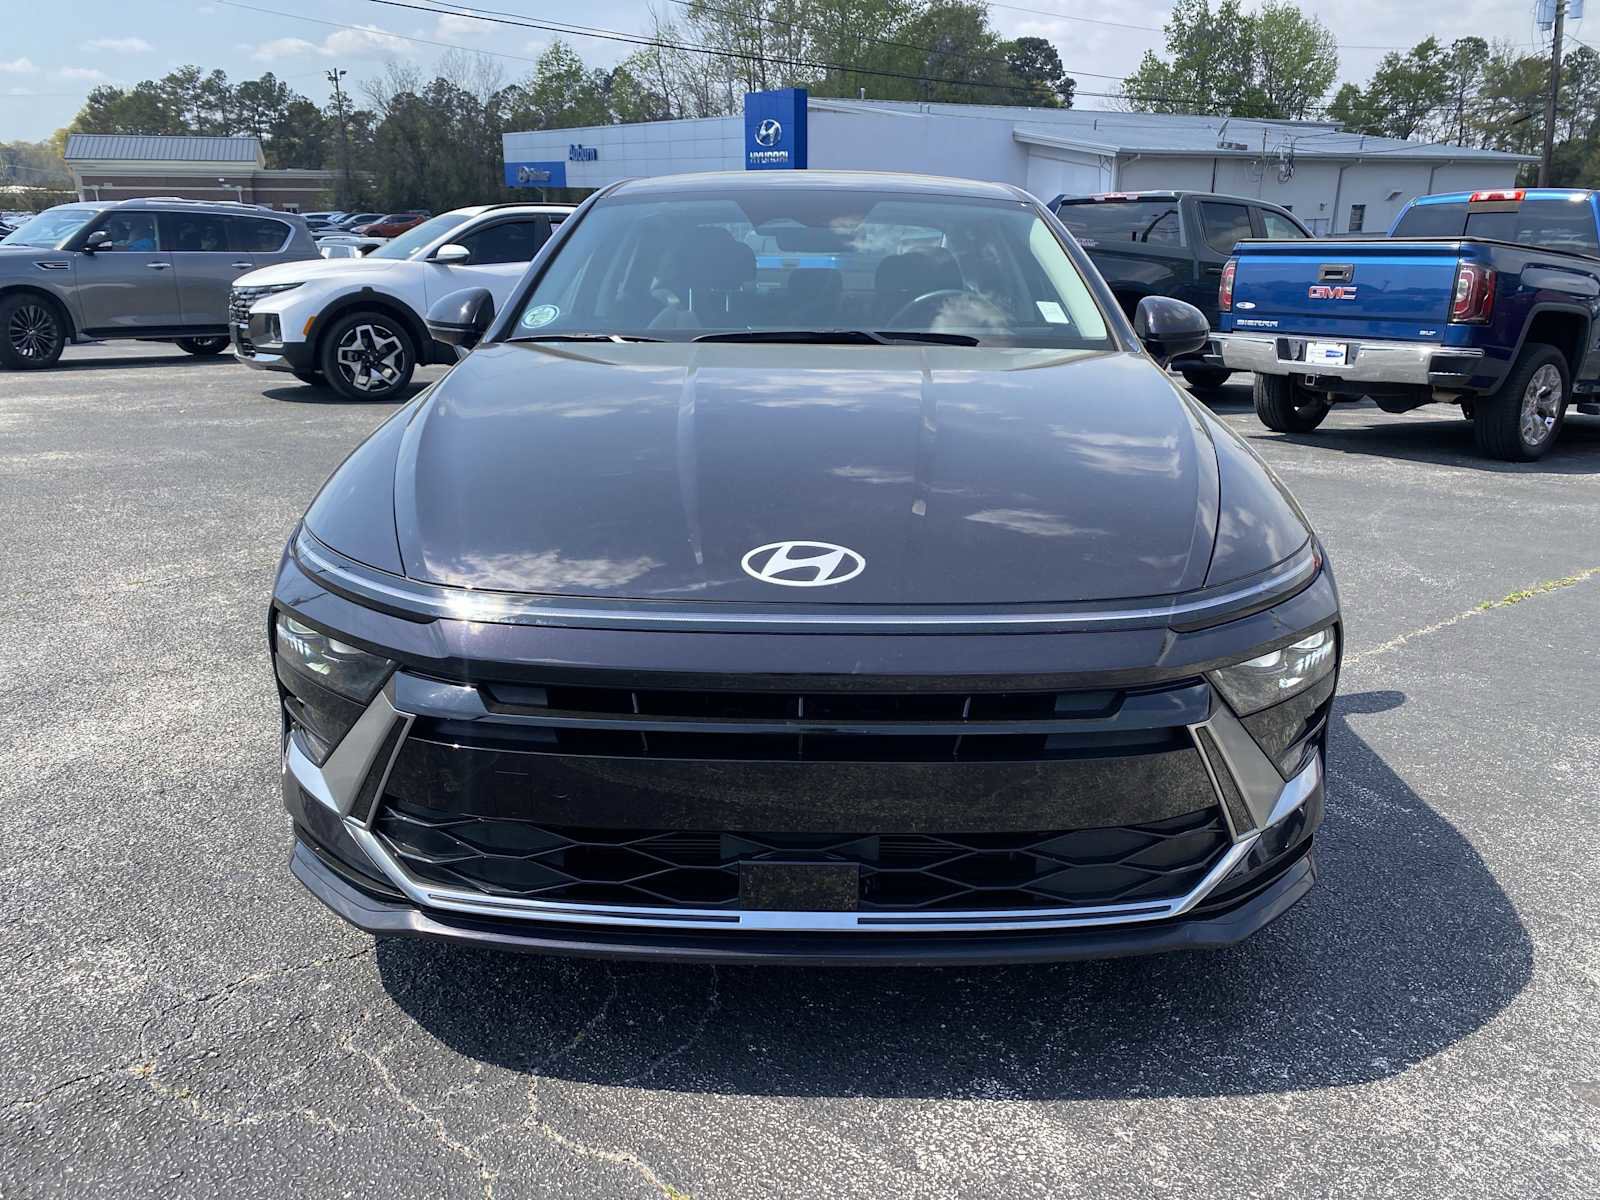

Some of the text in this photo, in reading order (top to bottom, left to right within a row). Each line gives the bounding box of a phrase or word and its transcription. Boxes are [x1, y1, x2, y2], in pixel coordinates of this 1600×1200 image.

[749, 151, 789, 163] HYUNDAI
[1308, 285, 1358, 300] GMC
[1236, 319, 1279, 328] SIERRA
